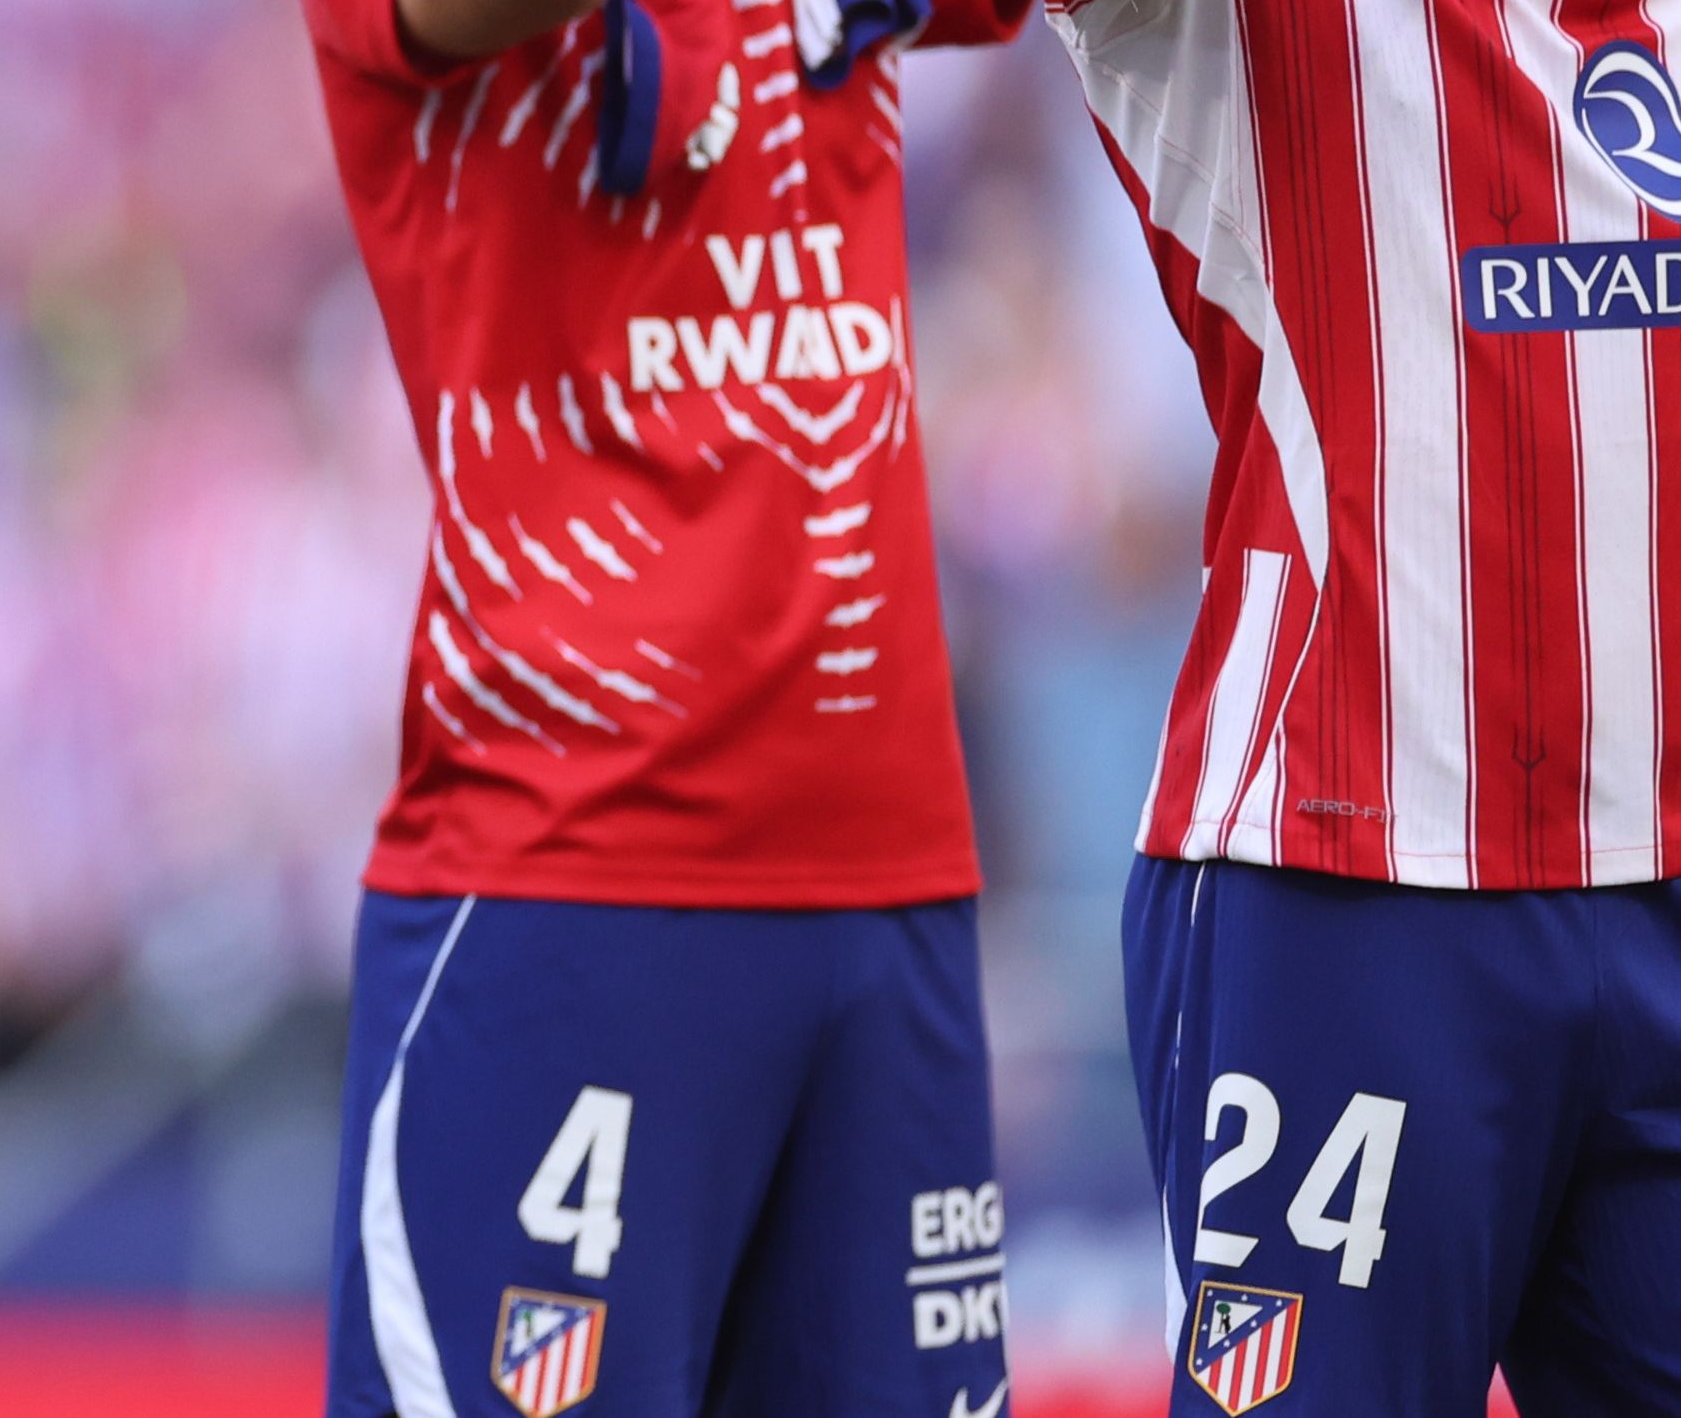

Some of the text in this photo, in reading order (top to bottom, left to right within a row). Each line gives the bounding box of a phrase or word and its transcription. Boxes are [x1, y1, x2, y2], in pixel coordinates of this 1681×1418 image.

[517, 1084, 634, 1279] 4
[911, 1180, 1005, 1259] ERG
[1193, 1072, 1408, 1290] 24
